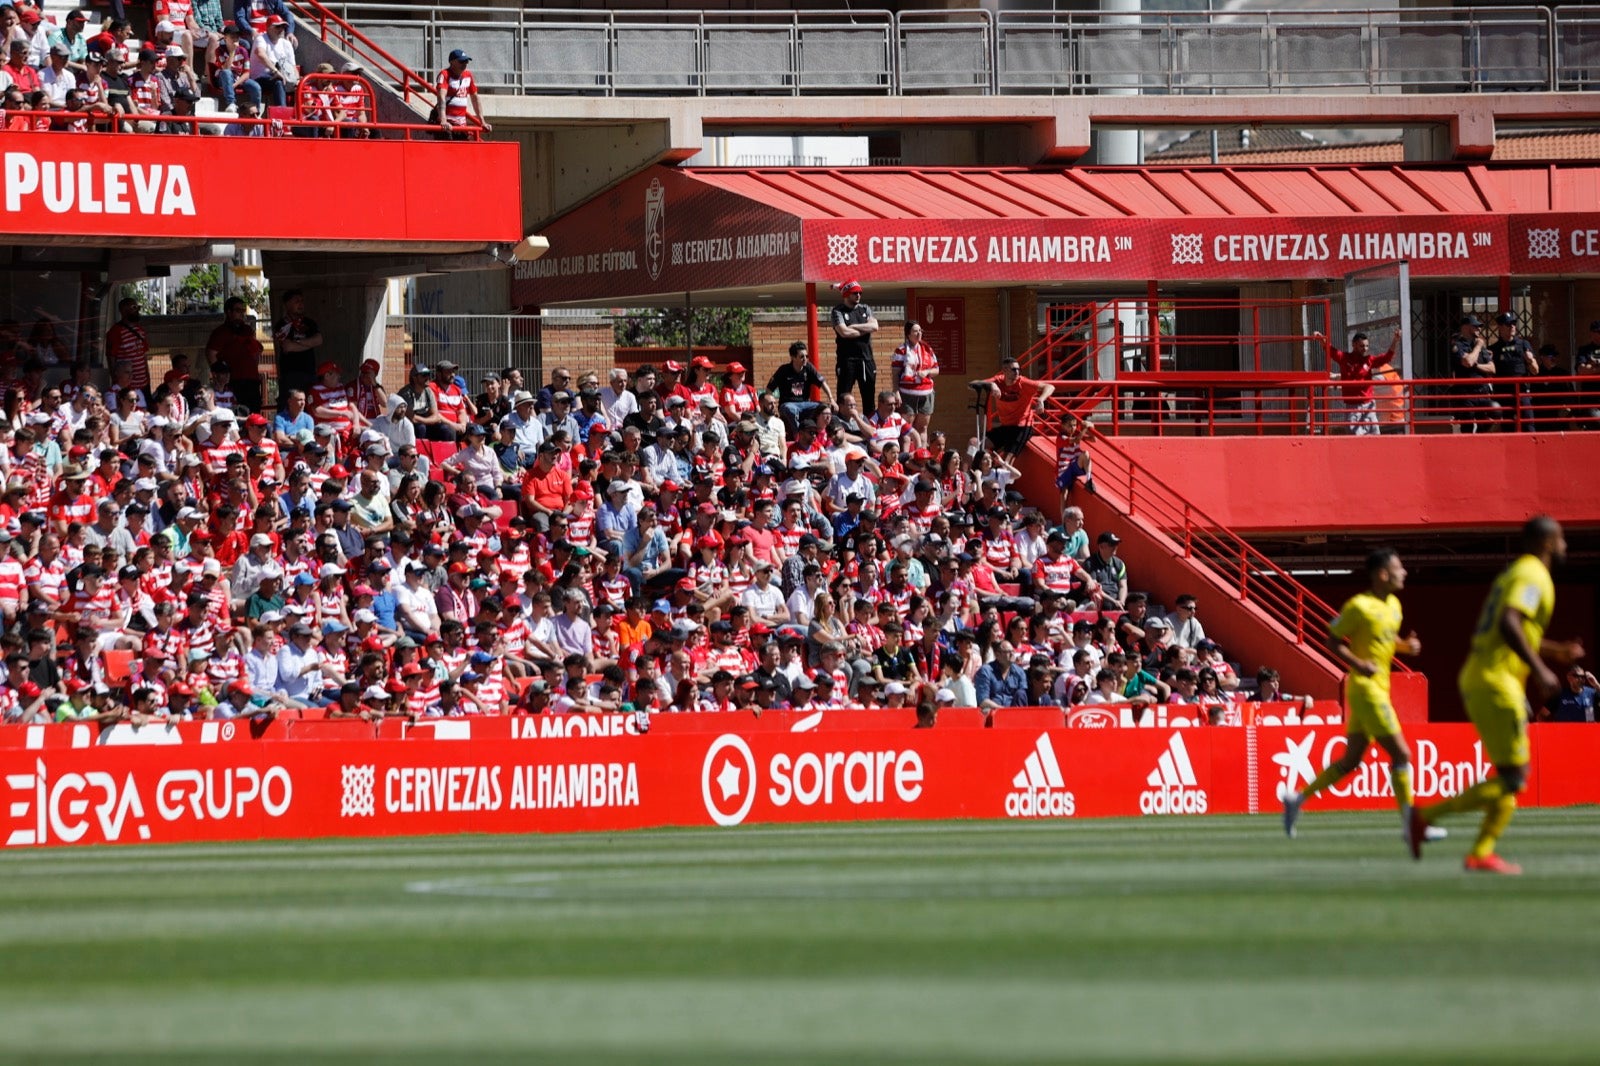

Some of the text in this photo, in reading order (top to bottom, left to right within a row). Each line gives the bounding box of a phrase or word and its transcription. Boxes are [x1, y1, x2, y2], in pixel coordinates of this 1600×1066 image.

[5, 152, 195, 215] PULEVA
[685, 238, 733, 264] CERVEZAS
[736, 232, 791, 259] ALHAMBRA
[868, 236, 1132, 264] CERVEZAS ALHAMBRA SIN
[1214, 232, 1491, 262] CERVEZAS ALHAMBRA SIN
[514, 248, 638, 280] GRANADA CLUB DE FÚTBOL
[769, 749, 924, 806] sorare
[1322, 735, 1492, 799] CaixBank
[156, 765, 293, 821] GRUPO
[385, 762, 640, 813] CERVEZAS ALHAMBRA
[1005, 785, 1075, 817] adidas
[1139, 784, 1208, 815] adidas
